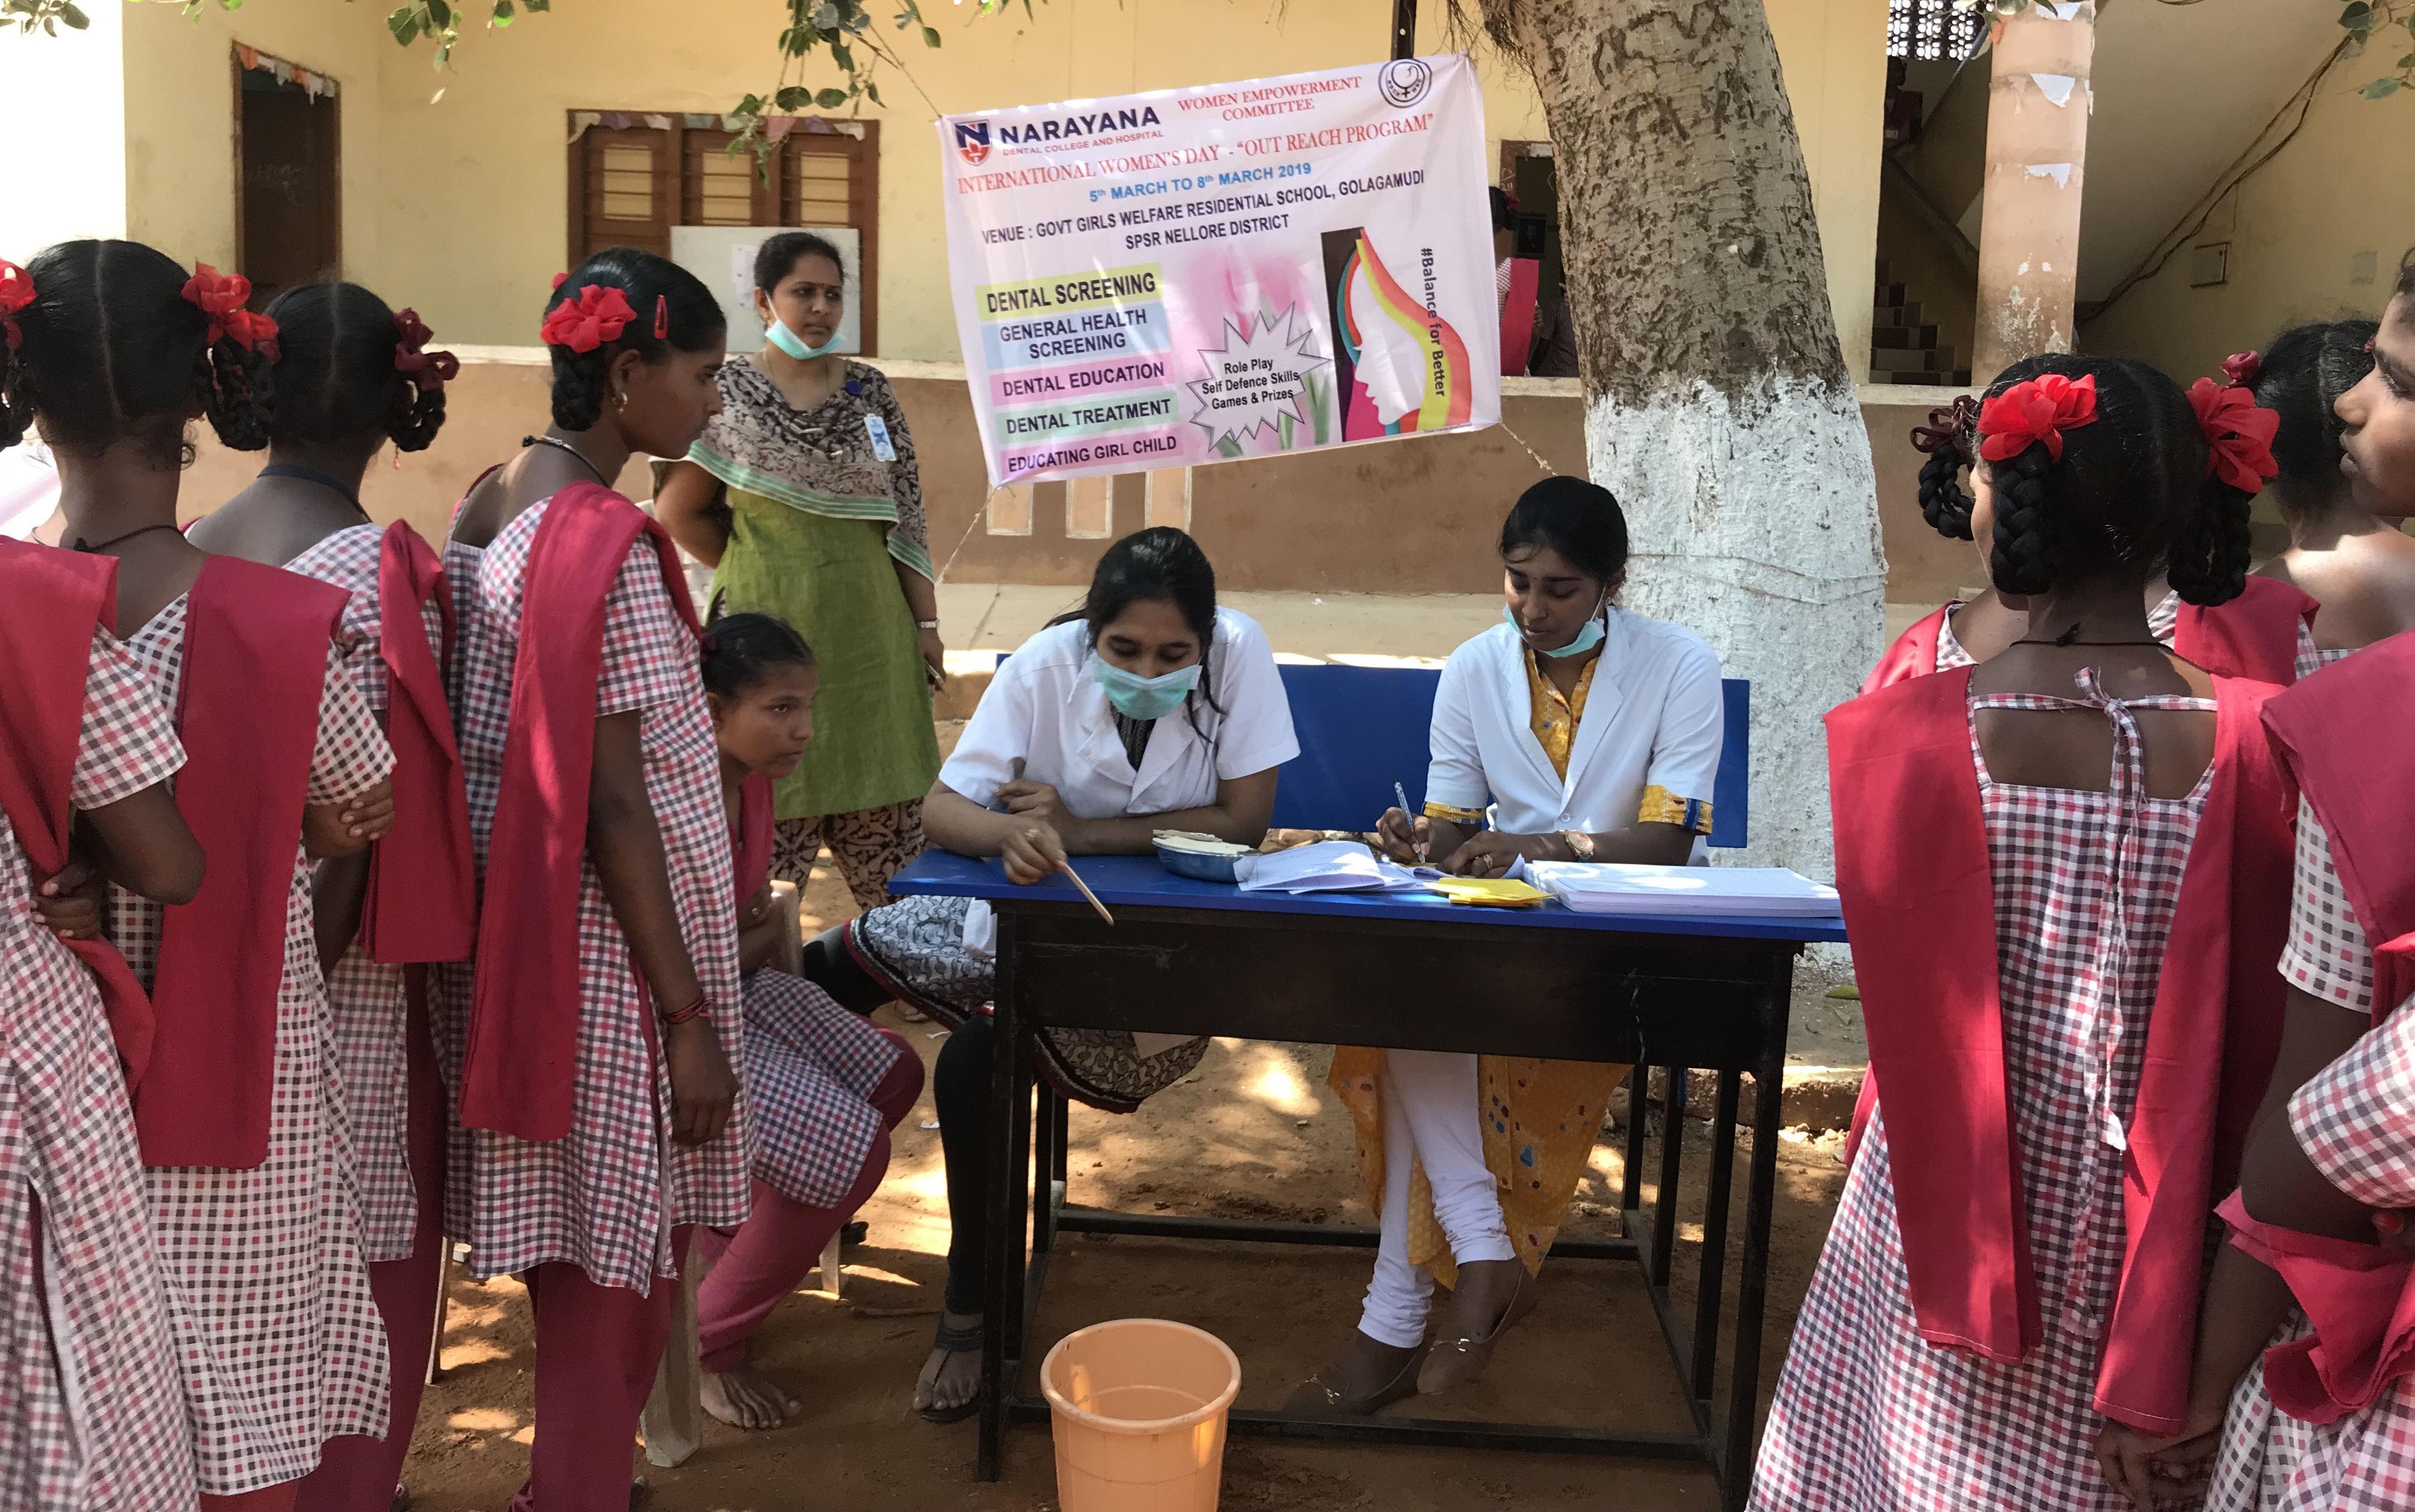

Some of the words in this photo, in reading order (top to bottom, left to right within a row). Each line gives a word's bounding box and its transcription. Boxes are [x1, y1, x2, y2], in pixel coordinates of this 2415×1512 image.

[1177, 92, 1238, 111] WOMEN
[1241, 76, 1362, 103] EMPOWERMENT
[1222, 98, 1315, 121] COMMITTEE
[1000, 106, 1161, 143] NARAYANA
[1002, 147, 1042, 155] DENTAL
[1045, 141, 1089, 152] COLLEGE
[1092, 137, 1114, 147] AND
[1116, 131, 1164, 143] HOSPITAL
[957, 163, 1096, 194] INTERNATIONAL
[1098, 150, 1181, 175] WOMEN’S
[1184, 145, 1219, 164] DAY
[1285, 128, 1342, 151] REACH
[1090, 189, 1106, 202] 5th
[1111, 181, 1168, 199] MARCH
[1171, 178, 1192, 191] TO
[1197, 175, 1213, 188] 8th
[1219, 167, 1273, 185] MARCH
[1278, 162, 1312, 178] 2019
[981, 226, 1025, 244] VENUE
[1036, 220, 1072, 237] GOVT
[1076, 213, 1116, 232] GIRLS
[1119, 205, 1183, 226] WELFARE
[1187, 193, 1273, 217] RESIDENTIAL
[1276, 185, 1335, 205] SCHOOL,
[1338, 169, 1425, 196] GOLAGAMUDI
[1126, 232, 1162, 250] SPSR
[1165, 223, 1226, 244] NELLORE
[1230, 214, 1289, 235] DISTRICT
[986, 287, 1051, 313] DENTAL
[1055, 272, 1155, 304] SCREENING
[1420, 247, 1437, 318] #Balance
[999, 319, 1077, 342] GENERAL
[1082, 309, 1147, 331] HEALTH
[1429, 322, 1442, 345] for
[1030, 332, 1126, 359] SCREENING
[1003, 375, 1065, 397] DENTAL
[1070, 362, 1165, 388] EDUCATION
[1202, 381, 1222, 394] Self
[1225, 376, 1267, 391] Defence
[1270, 370, 1299, 384] Skills
[1224, 361, 1248, 375] Role
[1251, 358, 1273, 371] Play
[1432, 350, 1445, 396] Better
[1006, 413, 1069, 434] DENTAL
[1073, 399, 1171, 425] TREATMENT
[1211, 396, 1247, 409] Games
[1251, 392, 1259, 404] &
[1261, 389, 1293, 402] Prizes
[1008, 448, 1090, 472] EDUCATING
[1094, 442, 1129, 459] GIRL
[1133, 436, 1177, 453] CHILD
